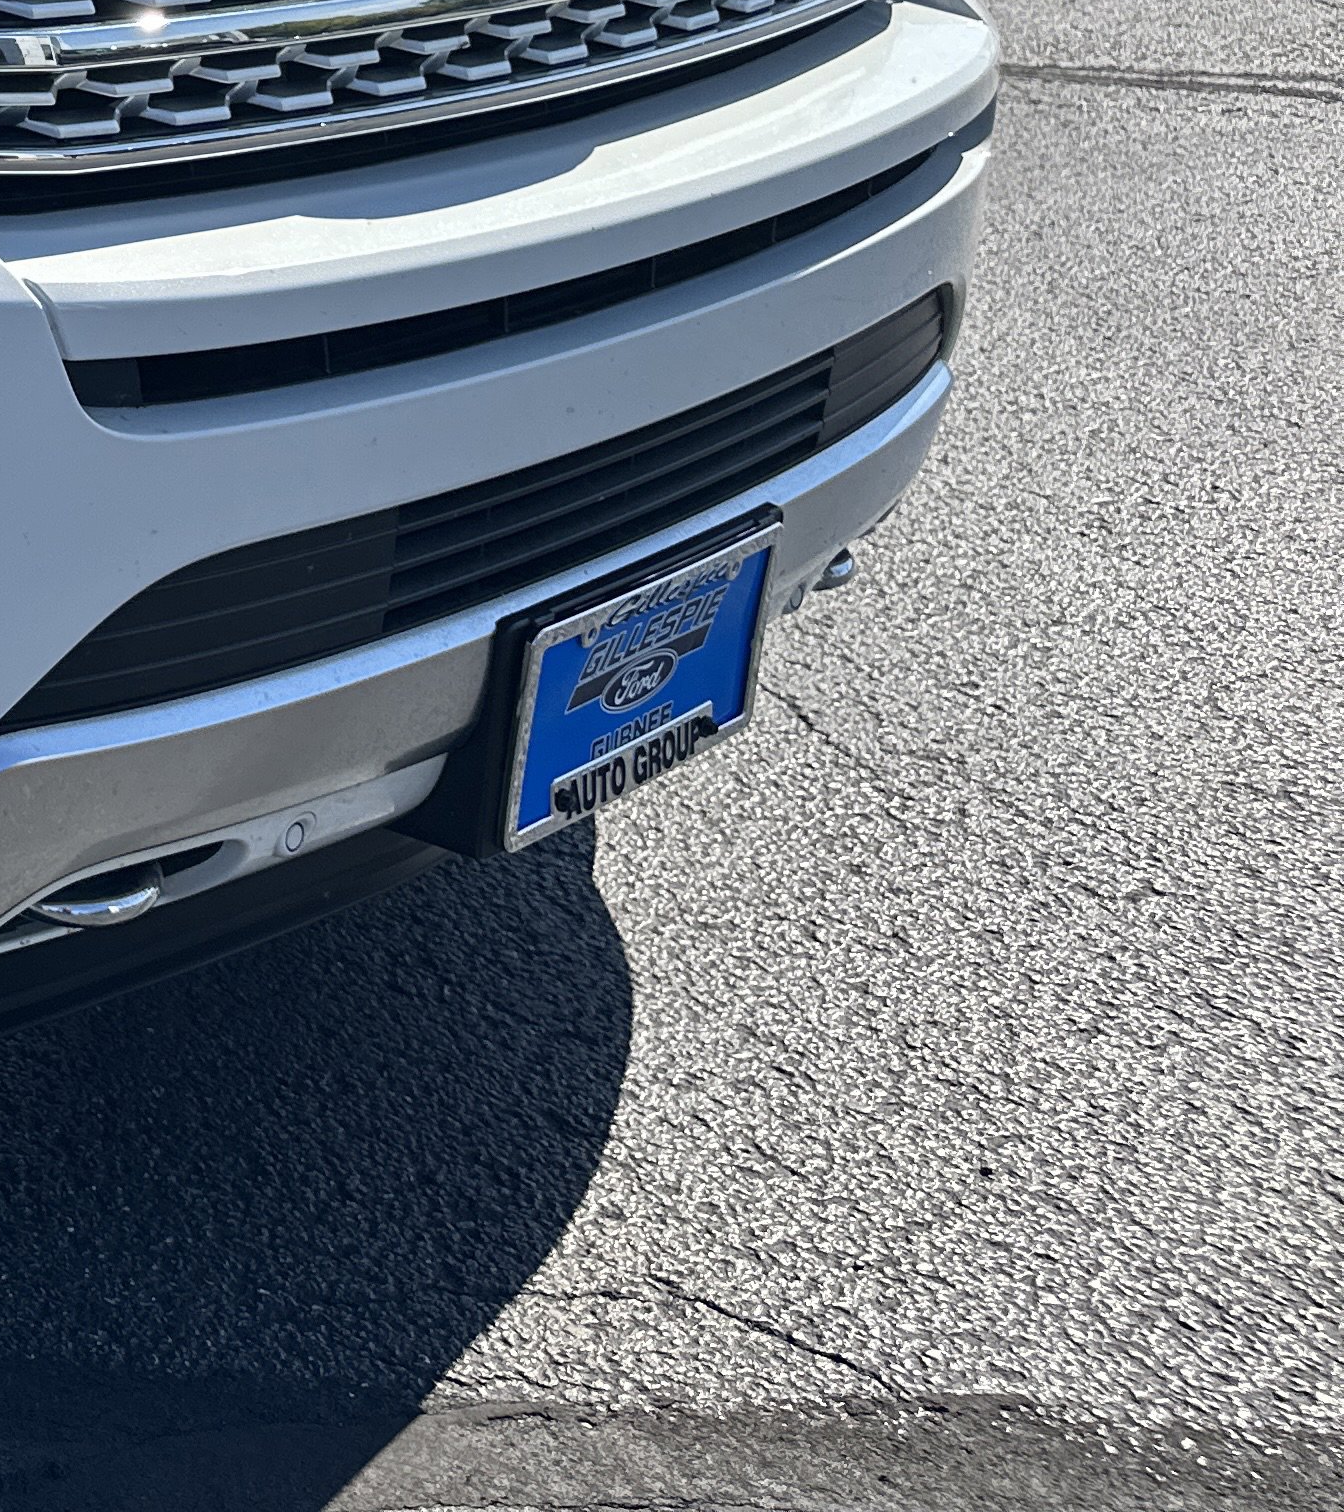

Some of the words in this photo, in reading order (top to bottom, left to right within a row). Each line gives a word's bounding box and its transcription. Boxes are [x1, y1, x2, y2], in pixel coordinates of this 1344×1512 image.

[578, 583, 730, 683] GILLESPIE
[614, 660, 664, 706] Ford
[565, 756, 626, 821] AUTO
[633, 716, 700, 785] GROUP
